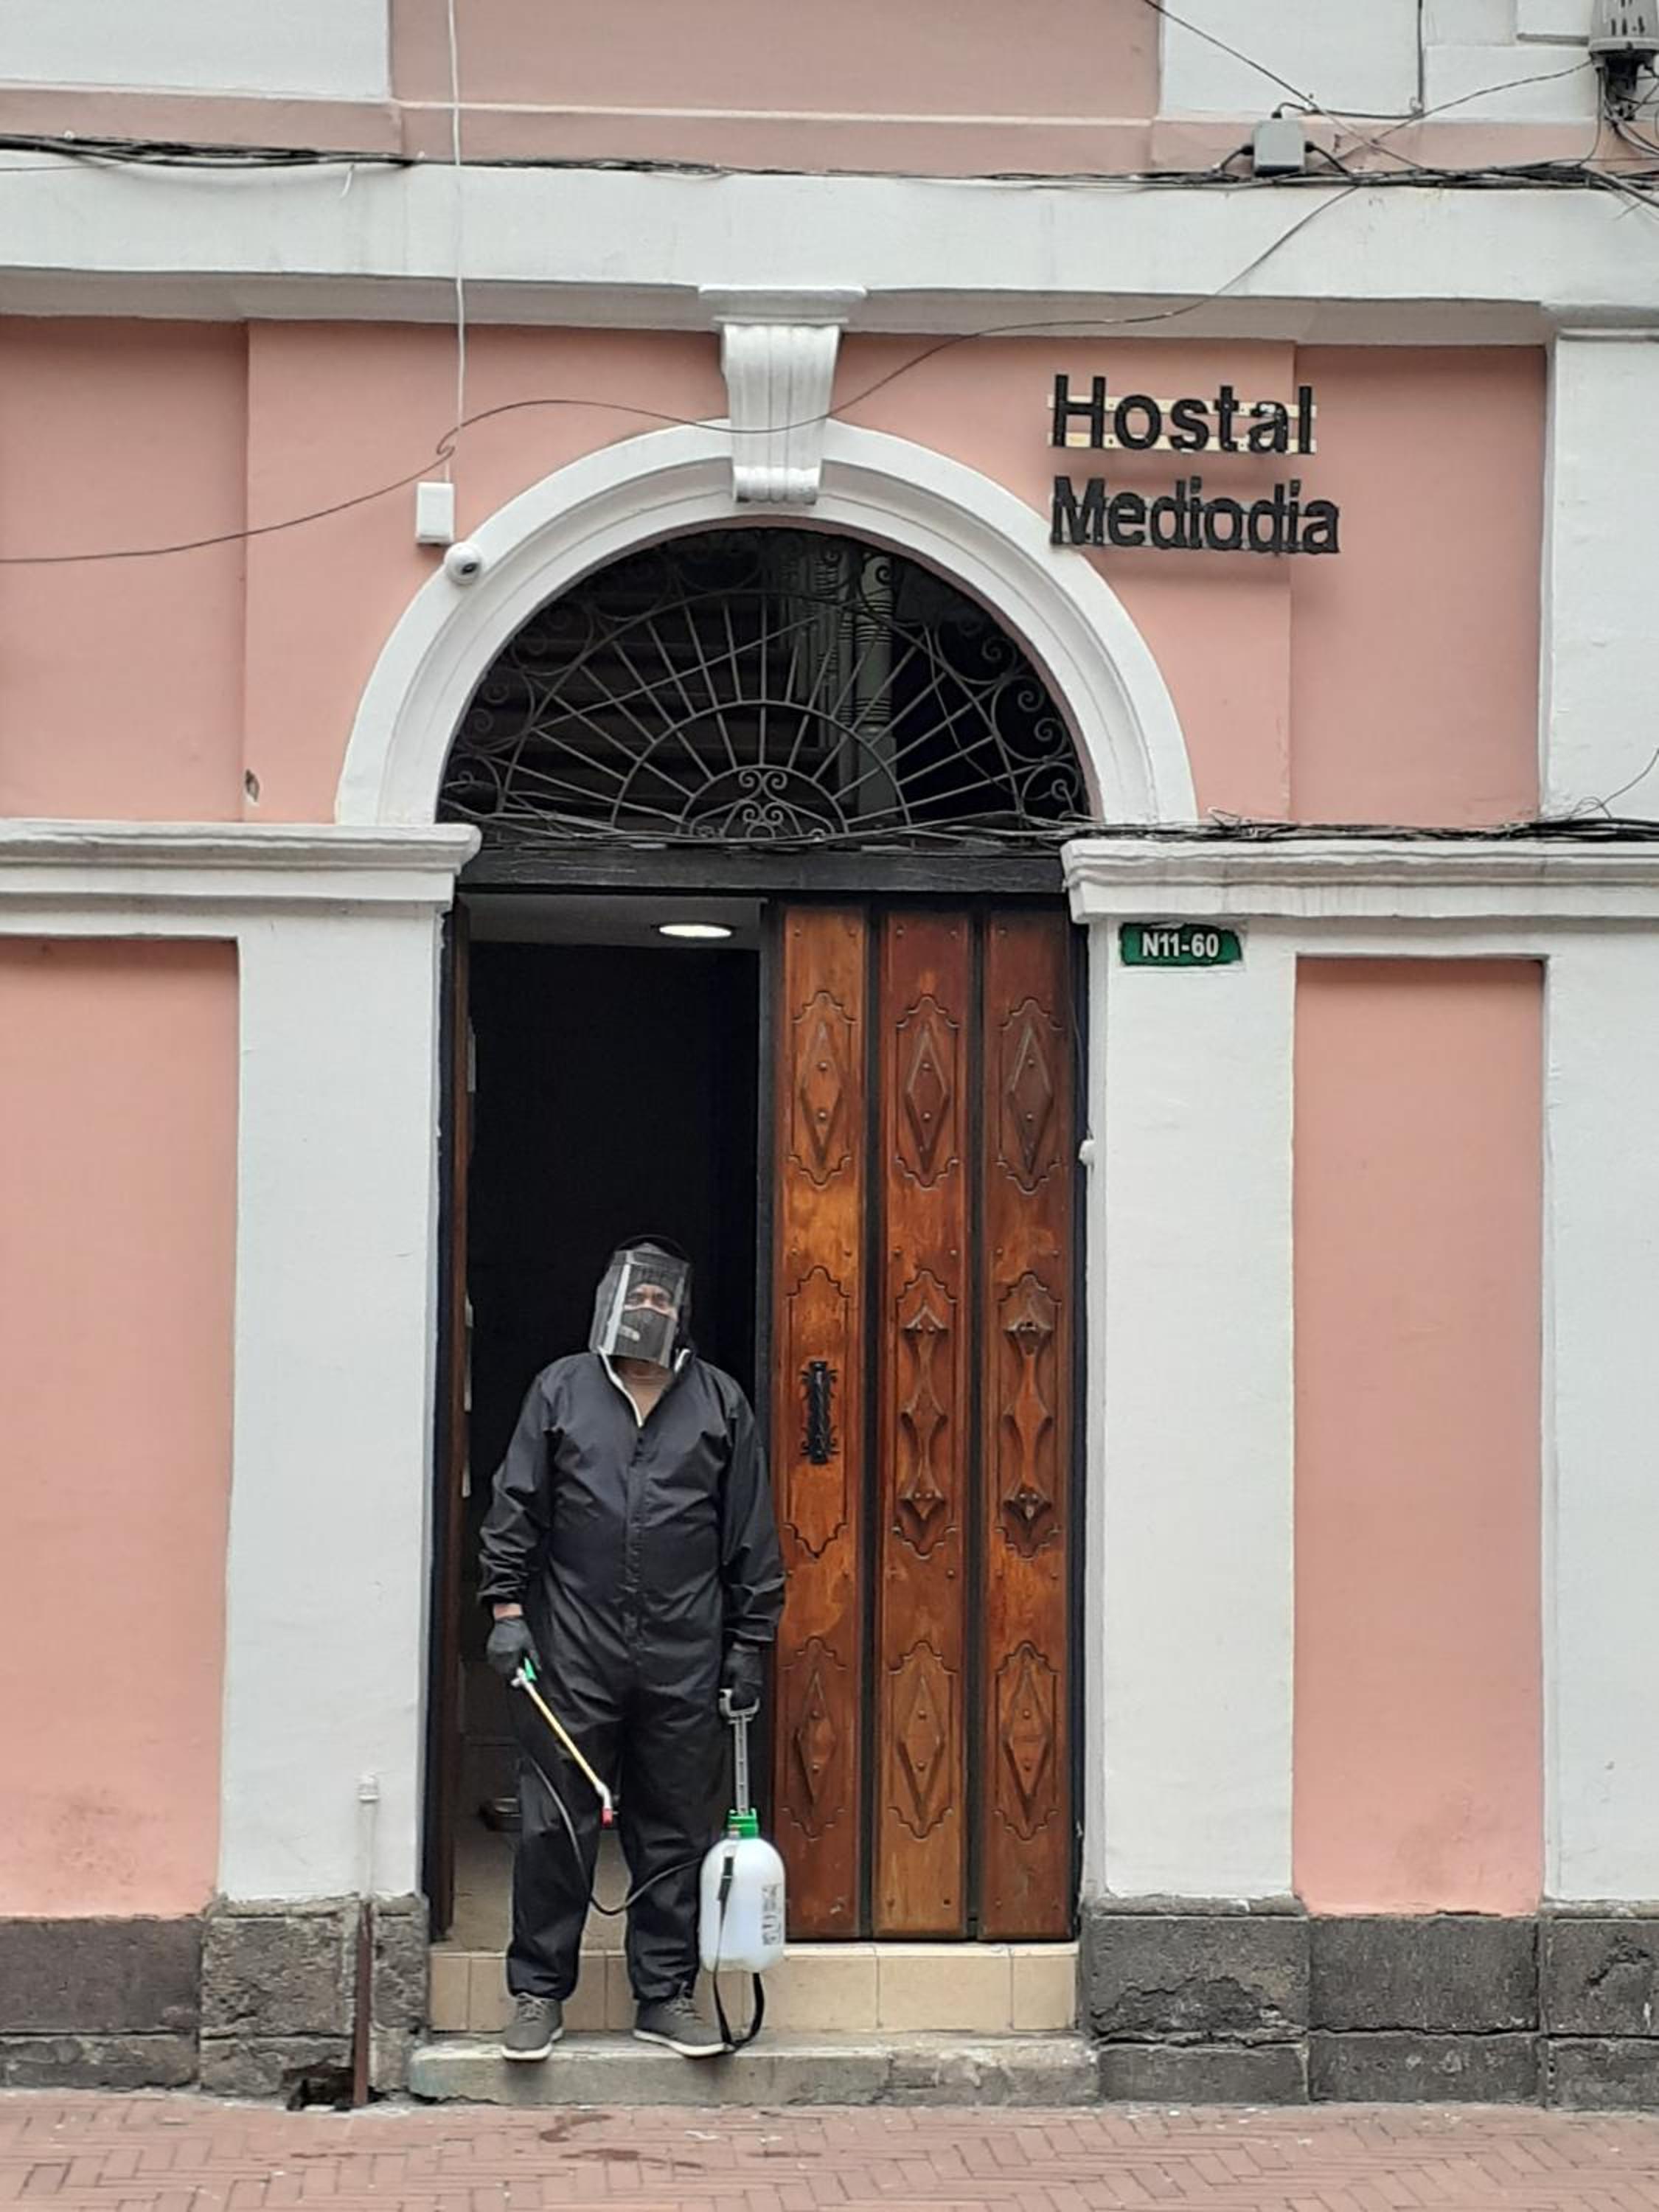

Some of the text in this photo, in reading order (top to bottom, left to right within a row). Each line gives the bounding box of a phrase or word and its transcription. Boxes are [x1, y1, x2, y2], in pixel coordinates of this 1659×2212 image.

[1052, 374, 1313, 454] Hostal
[1049, 475, 1340, 554] Mediodia
[1143, 932, 1220, 958] N11-60
